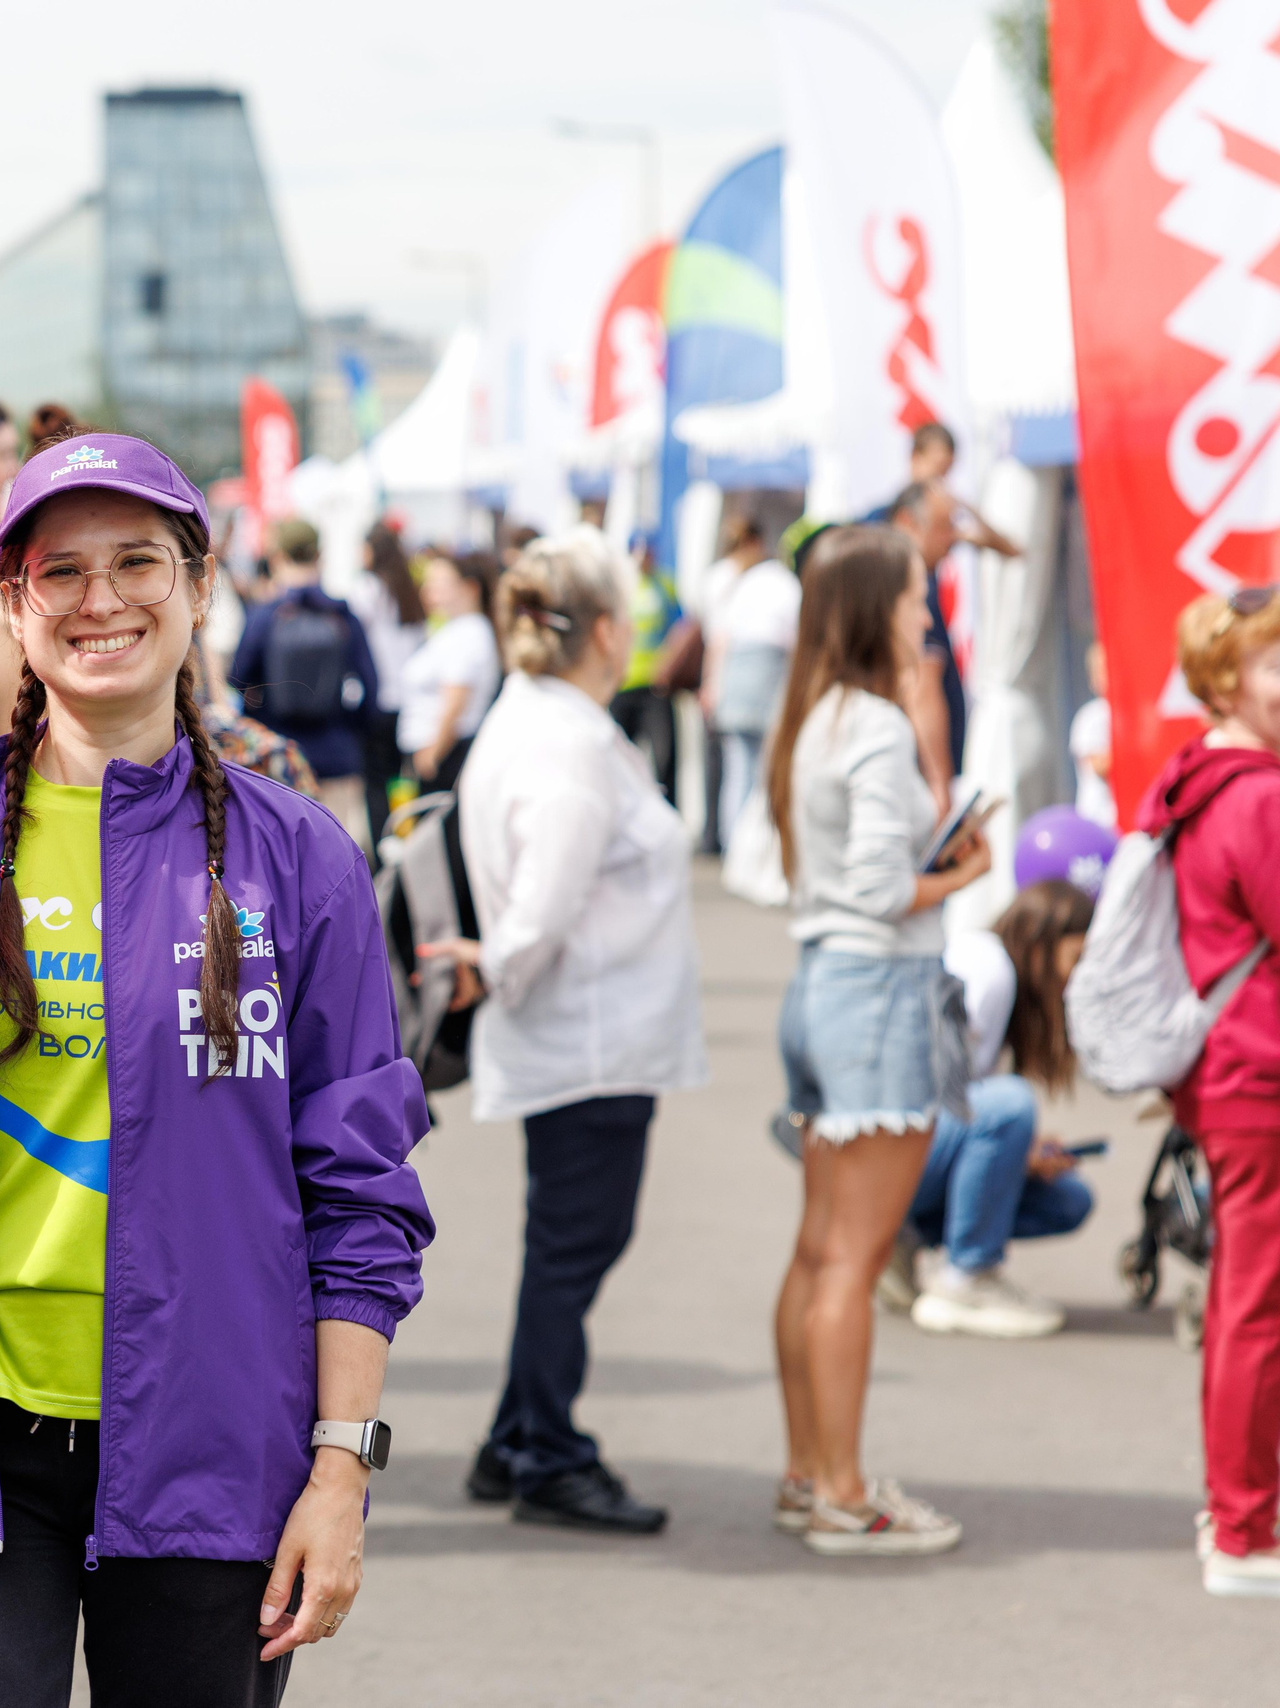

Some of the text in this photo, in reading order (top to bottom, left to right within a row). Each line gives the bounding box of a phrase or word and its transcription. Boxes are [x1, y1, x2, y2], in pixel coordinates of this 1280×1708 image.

[50, 459, 118, 482] parmalat
[173, 936, 276, 964] paala
[179, 1034, 286, 1080] TEIN
